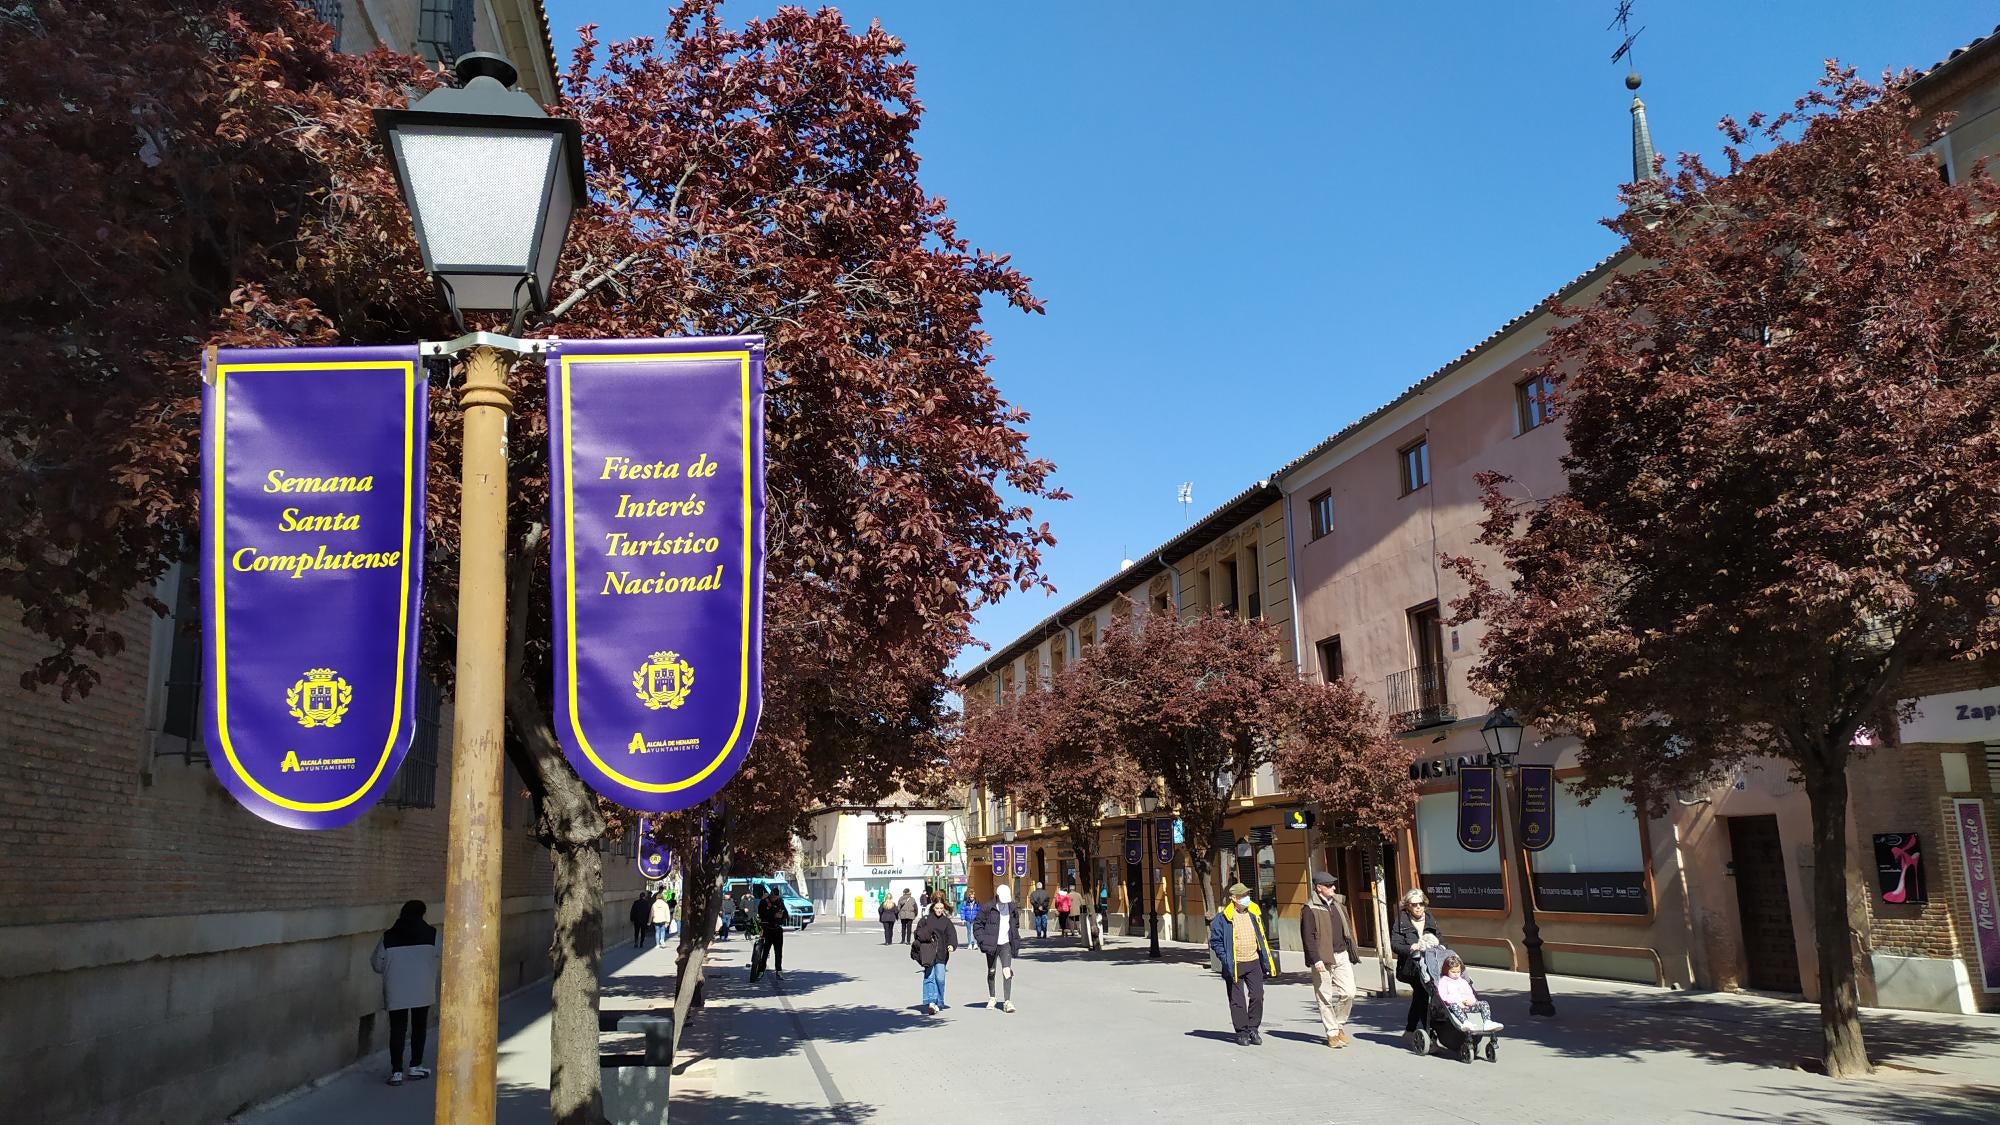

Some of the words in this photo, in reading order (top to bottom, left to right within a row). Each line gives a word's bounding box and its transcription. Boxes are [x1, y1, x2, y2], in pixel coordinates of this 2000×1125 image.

[601, 456, 680, 480] Fiesta
[687, 453, 718, 478] de
[264, 469, 373, 494] Semana
[615, 494, 705, 518] Interés
[278, 508, 360, 532] Santa
[606, 532, 720, 556] Turístico
[232, 545, 400, 579] Complutense
[601, 564, 723, 595] Nacional
[1955, 704, 2000, 721] Zap
[646, 740, 667, 748] ALCALÁ
[646, 744, 700, 753] AYUNTAMIENTO
[300, 758, 322, 766] ALCALÁ
[300, 764, 356, 772] AYUNTAMIENTO
[1964, 818, 1984, 881] calzado
[1978, 888, 1994, 930] Moda
